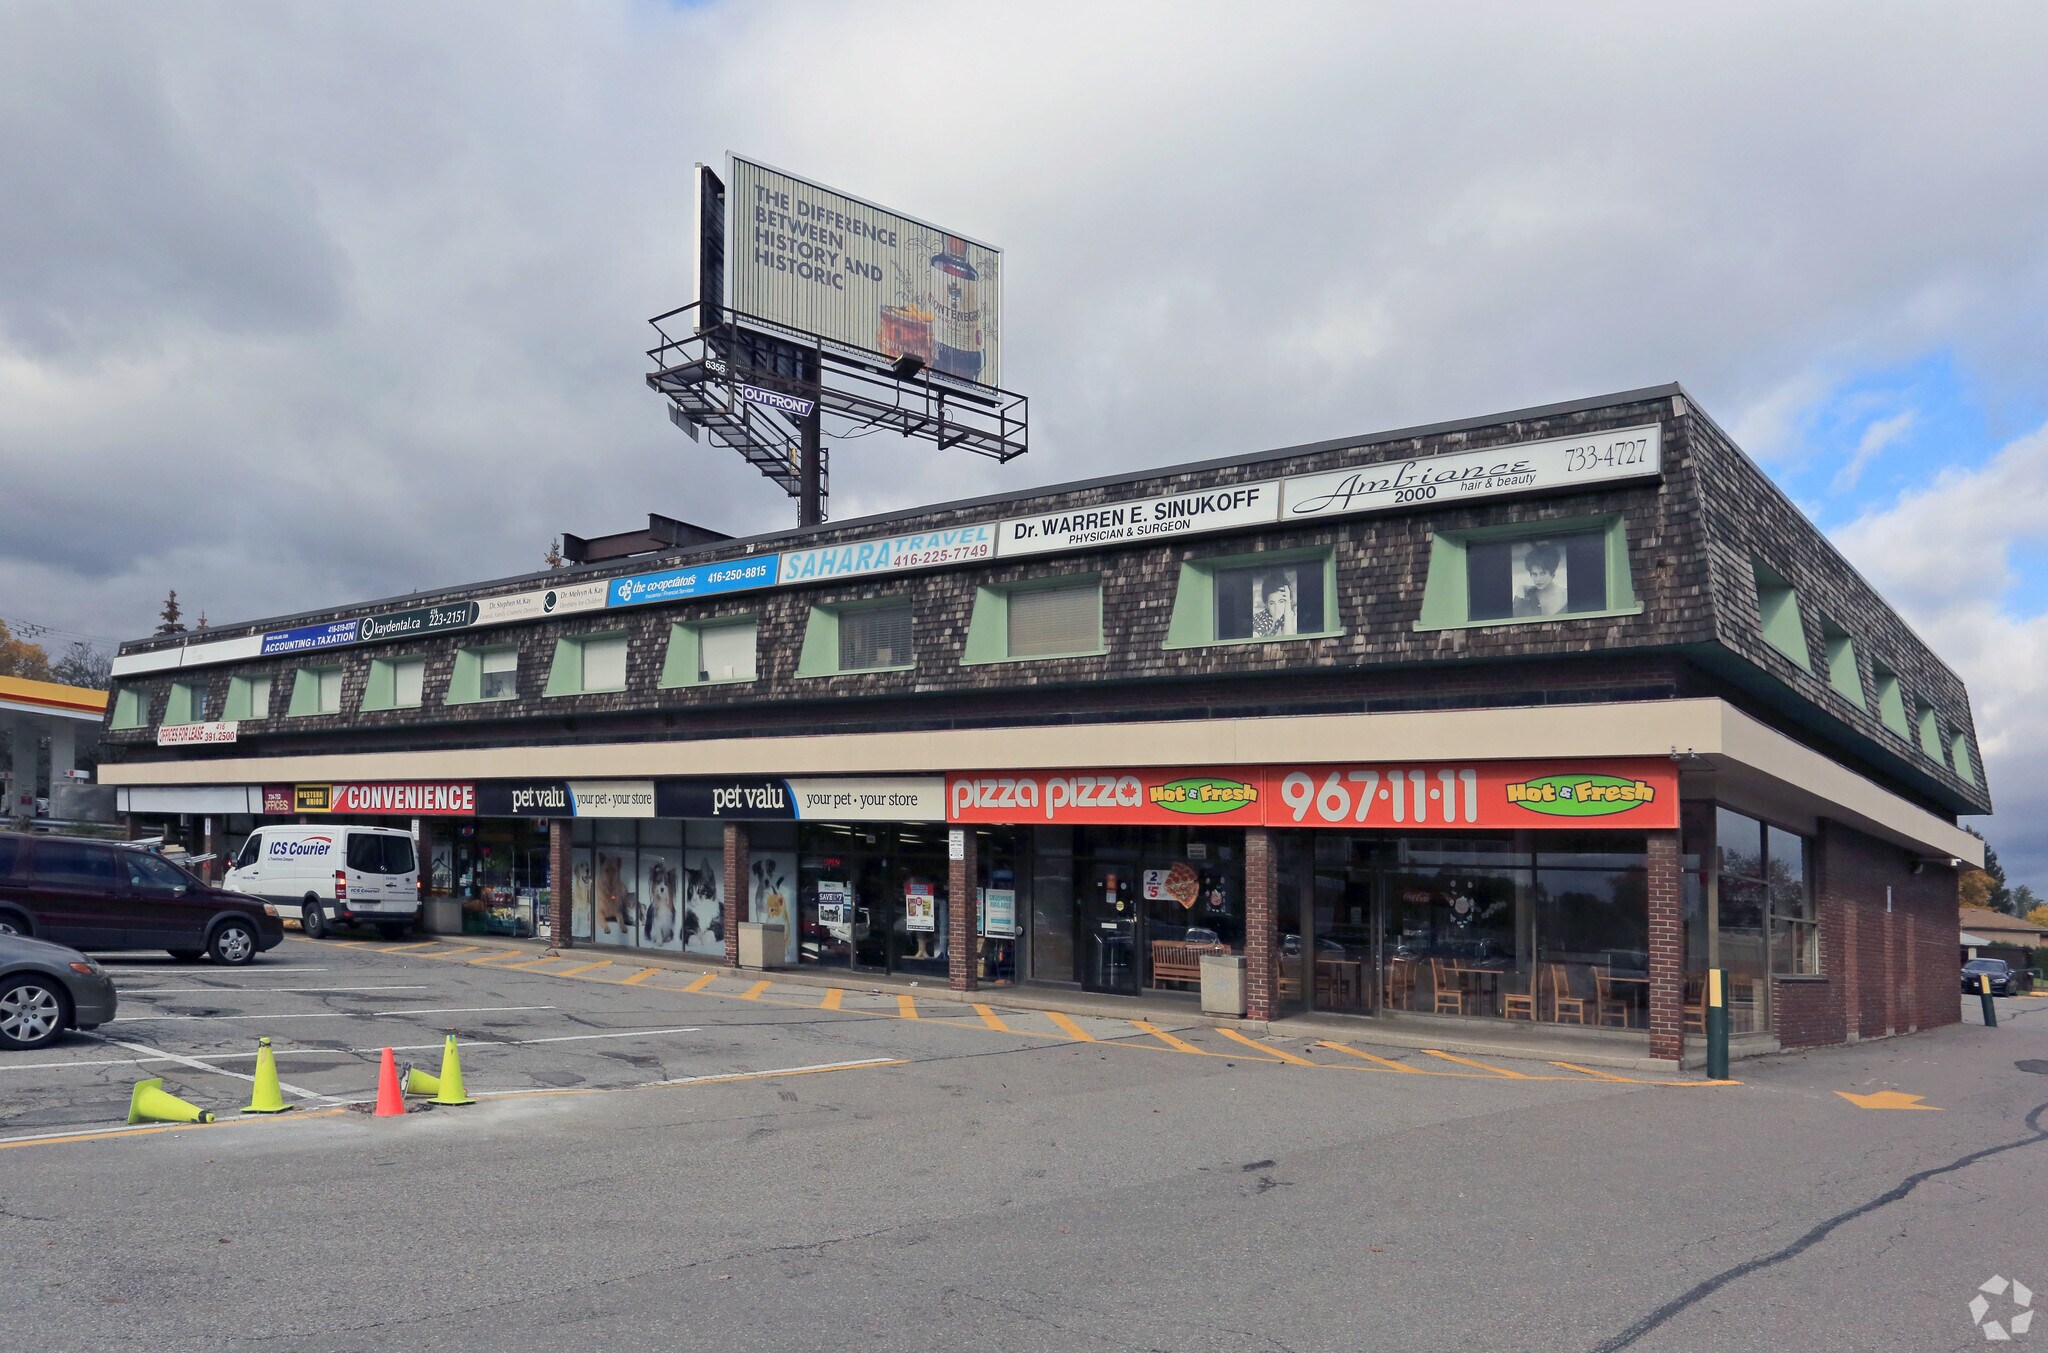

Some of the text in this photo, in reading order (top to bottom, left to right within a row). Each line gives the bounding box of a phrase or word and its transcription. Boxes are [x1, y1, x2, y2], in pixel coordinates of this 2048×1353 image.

[755, 184, 897, 248] THE DIFFERENCE
[756, 205, 843, 250] BETWEEN
[755, 226, 883, 282] HISTORY AND
[705, 360, 726, 373] 6356
[744, 387, 809, 414] OUTFRONT
[1292, 439, 1648, 514] Ambiance 733-4727
[1395, 473, 1537, 504] 2000 hair & beauty
[1014, 488, 1260, 540] Dr. WARREN E. SINUKOFF
[1068, 519, 1192, 545] PHYSICIAN & SURGEON
[785, 527, 990, 580] SAHARA TRAVEL
[893, 543, 989, 567] 416-225-7749
[632, 565, 767, 593] the co-operators 416-250-8815
[374, 610, 466, 637] kaydental.ca 223-2151
[264, 631, 355, 653] ACCOUNTING & TAXATION
[204, 731, 235, 742] 391.2500
[306, 798, 323, 806] UNION
[348, 785, 473, 810] CONVENIENCE
[512, 786, 566, 813] pet valu
[577, 792, 652, 808] your pet your store
[713, 783, 784, 815] pet valu
[807, 793, 918, 810] your pet your store
[952, 775, 1143, 820] pizza pizza
[1149, 782, 1258, 803] Hot & Fresh
[1506, 781, 1655, 803] Hot & Fresh
[269, 841, 330, 856] ICS Courier
[1150, 871, 1158, 881] 2
[819, 893, 833, 901] SAVE
[1147, 886, 1159, 898] $5
